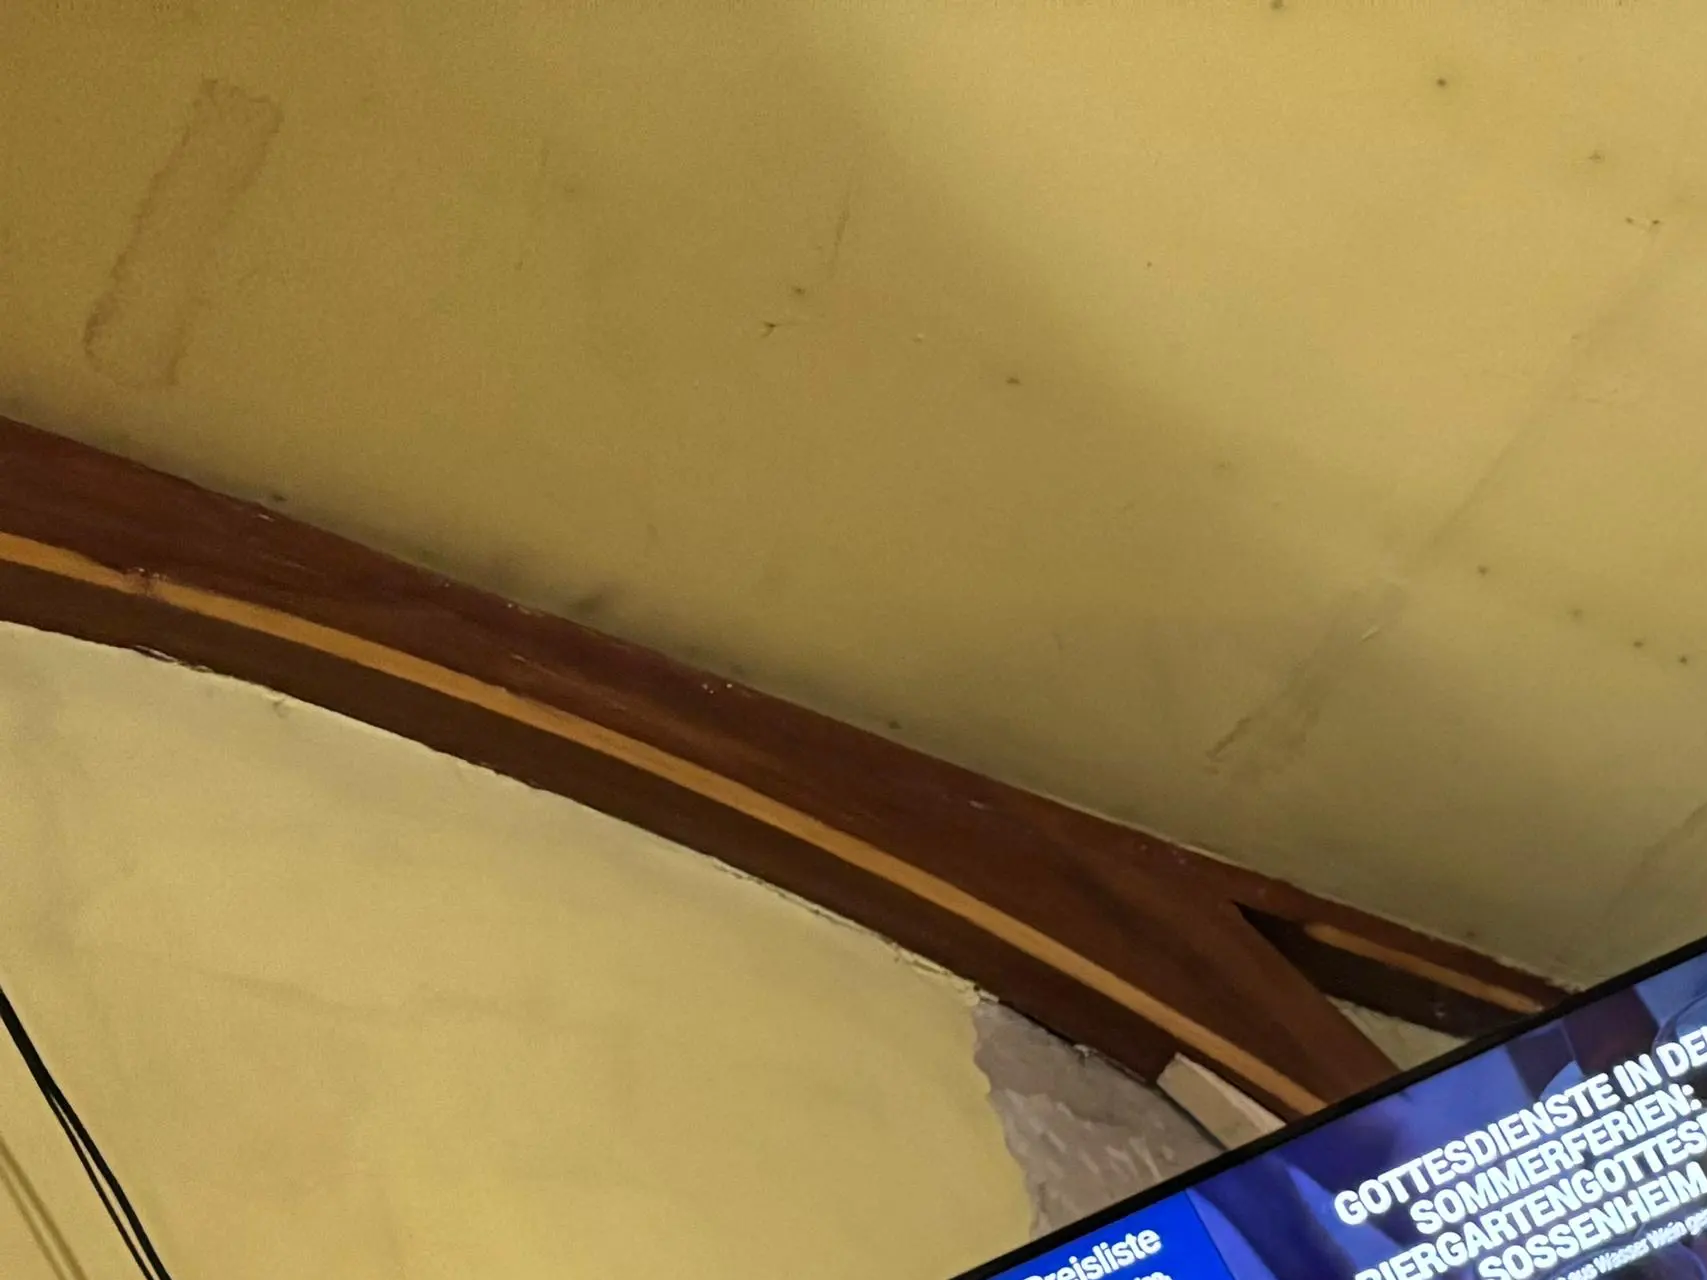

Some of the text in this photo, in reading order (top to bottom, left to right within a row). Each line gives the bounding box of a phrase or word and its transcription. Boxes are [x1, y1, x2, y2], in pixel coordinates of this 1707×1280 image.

[1332, 1073, 1616, 1227] GOTTESDIENSTE
[1615, 1053, 1660, 1096] IN
[1409, 1080, 1700, 1236] SOMMERFERIEN:
